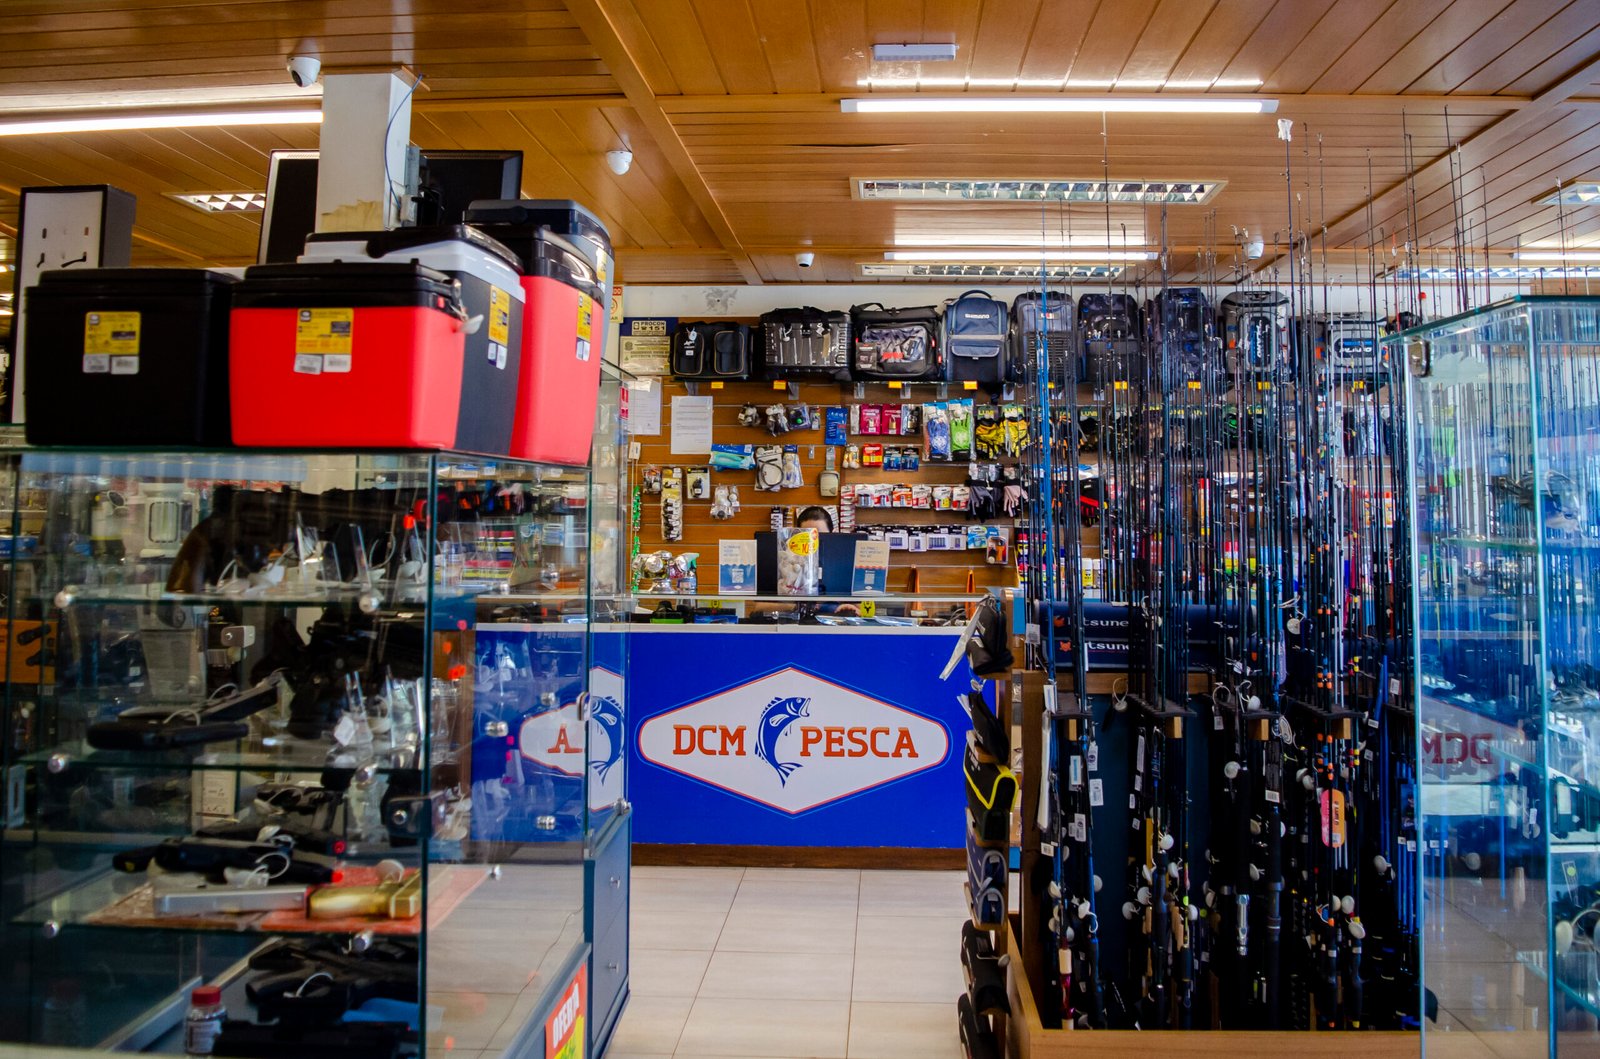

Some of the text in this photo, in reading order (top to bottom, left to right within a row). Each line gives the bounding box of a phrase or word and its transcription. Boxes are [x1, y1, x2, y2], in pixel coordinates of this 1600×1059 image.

[672, 724, 919, 758] DCM PESCA
[552, 982, 580, 1049] OFERTA
